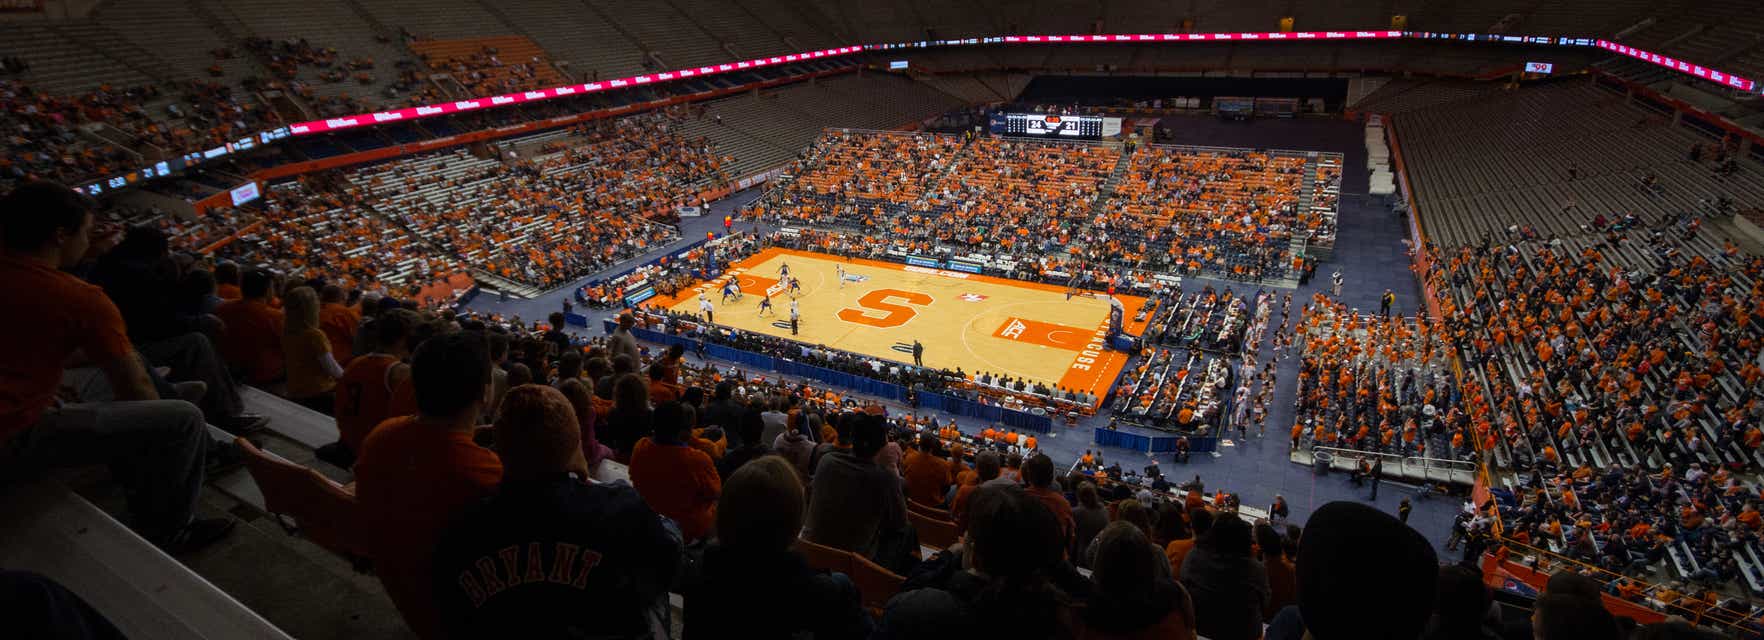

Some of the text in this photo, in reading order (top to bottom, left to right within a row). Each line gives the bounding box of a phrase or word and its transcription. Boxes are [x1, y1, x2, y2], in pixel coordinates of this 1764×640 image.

[1031, 120, 1042, 129] 24
[1065, 121, 1076, 130] 21
[835, 288, 935, 329] S
[1001, 319, 1026, 340] ACC
[457, 541, 604, 609] BRYANT
